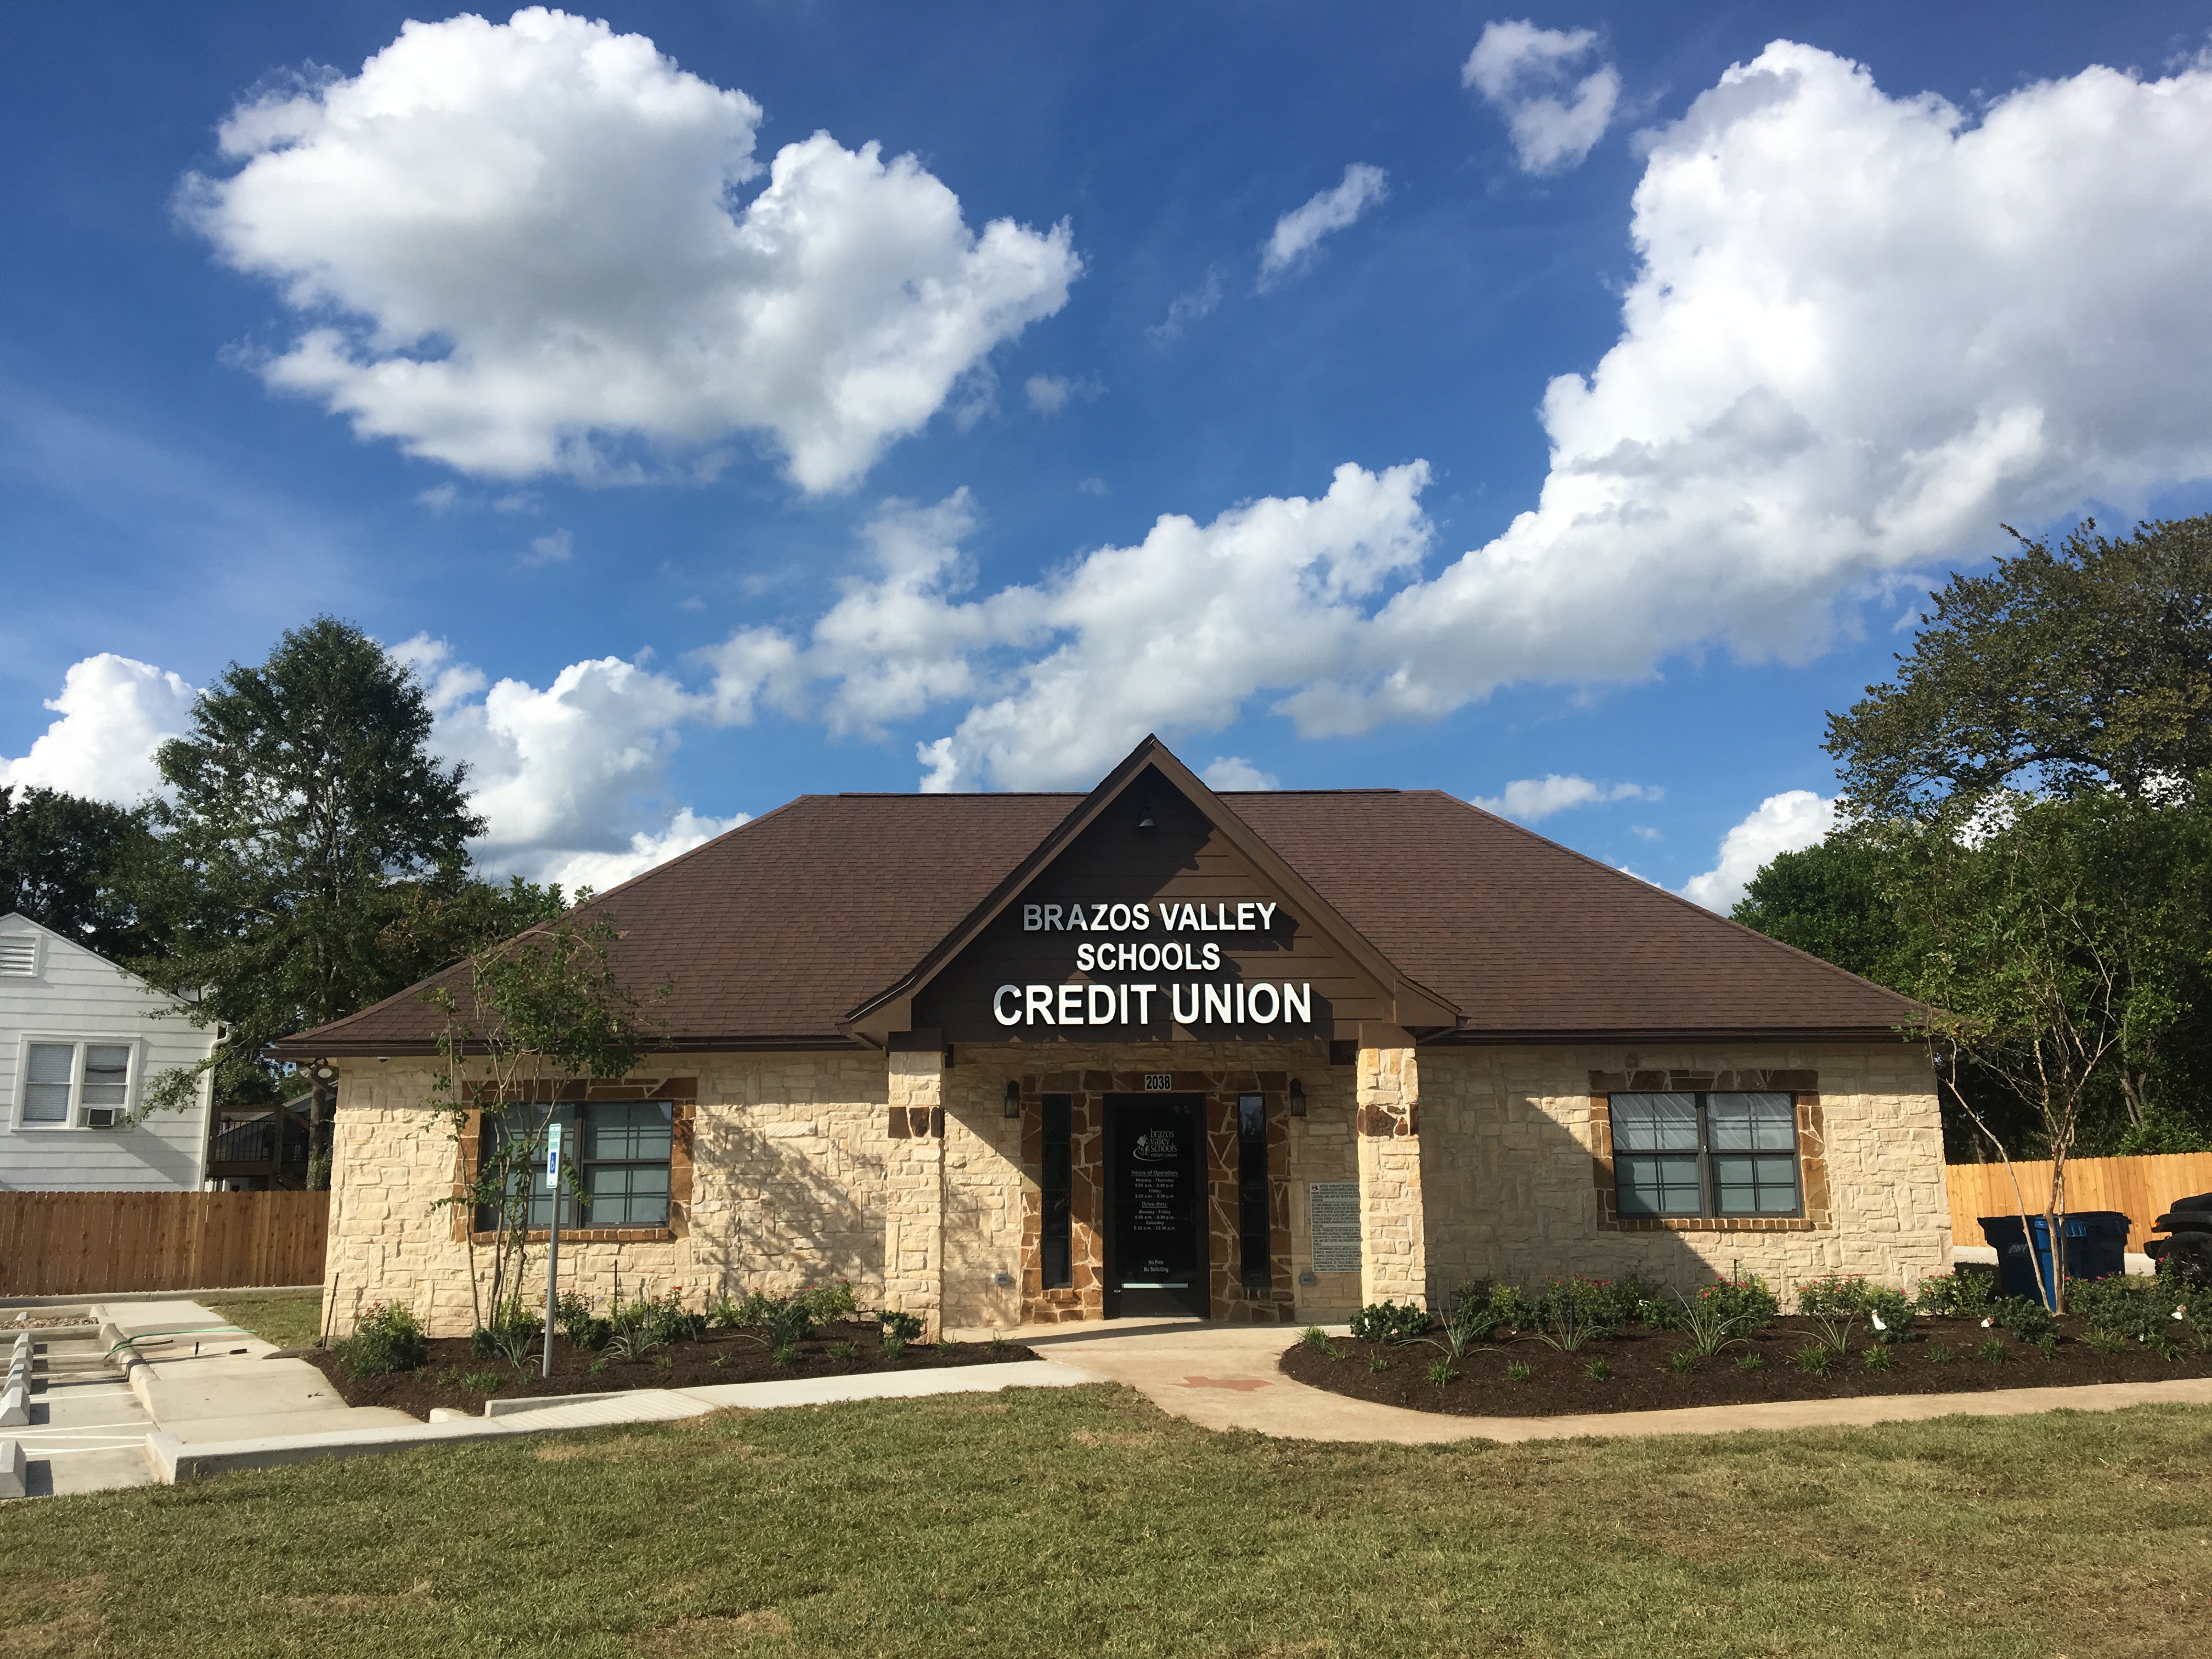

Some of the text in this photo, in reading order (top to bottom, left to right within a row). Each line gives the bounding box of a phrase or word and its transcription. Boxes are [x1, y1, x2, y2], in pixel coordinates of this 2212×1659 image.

[1023, 902, 1277, 932] BRAZOS VALLEY
[1076, 943, 1221, 971] SCHOOLS
[993, 983, 1312, 1026] CREDIT UNION
[1146, 1075, 1171, 1090] 2038
[1150, 1127, 1175, 1138] brazos
[1150, 1136, 1170, 1146] valley
[1150, 1142, 1177, 1152] schools
